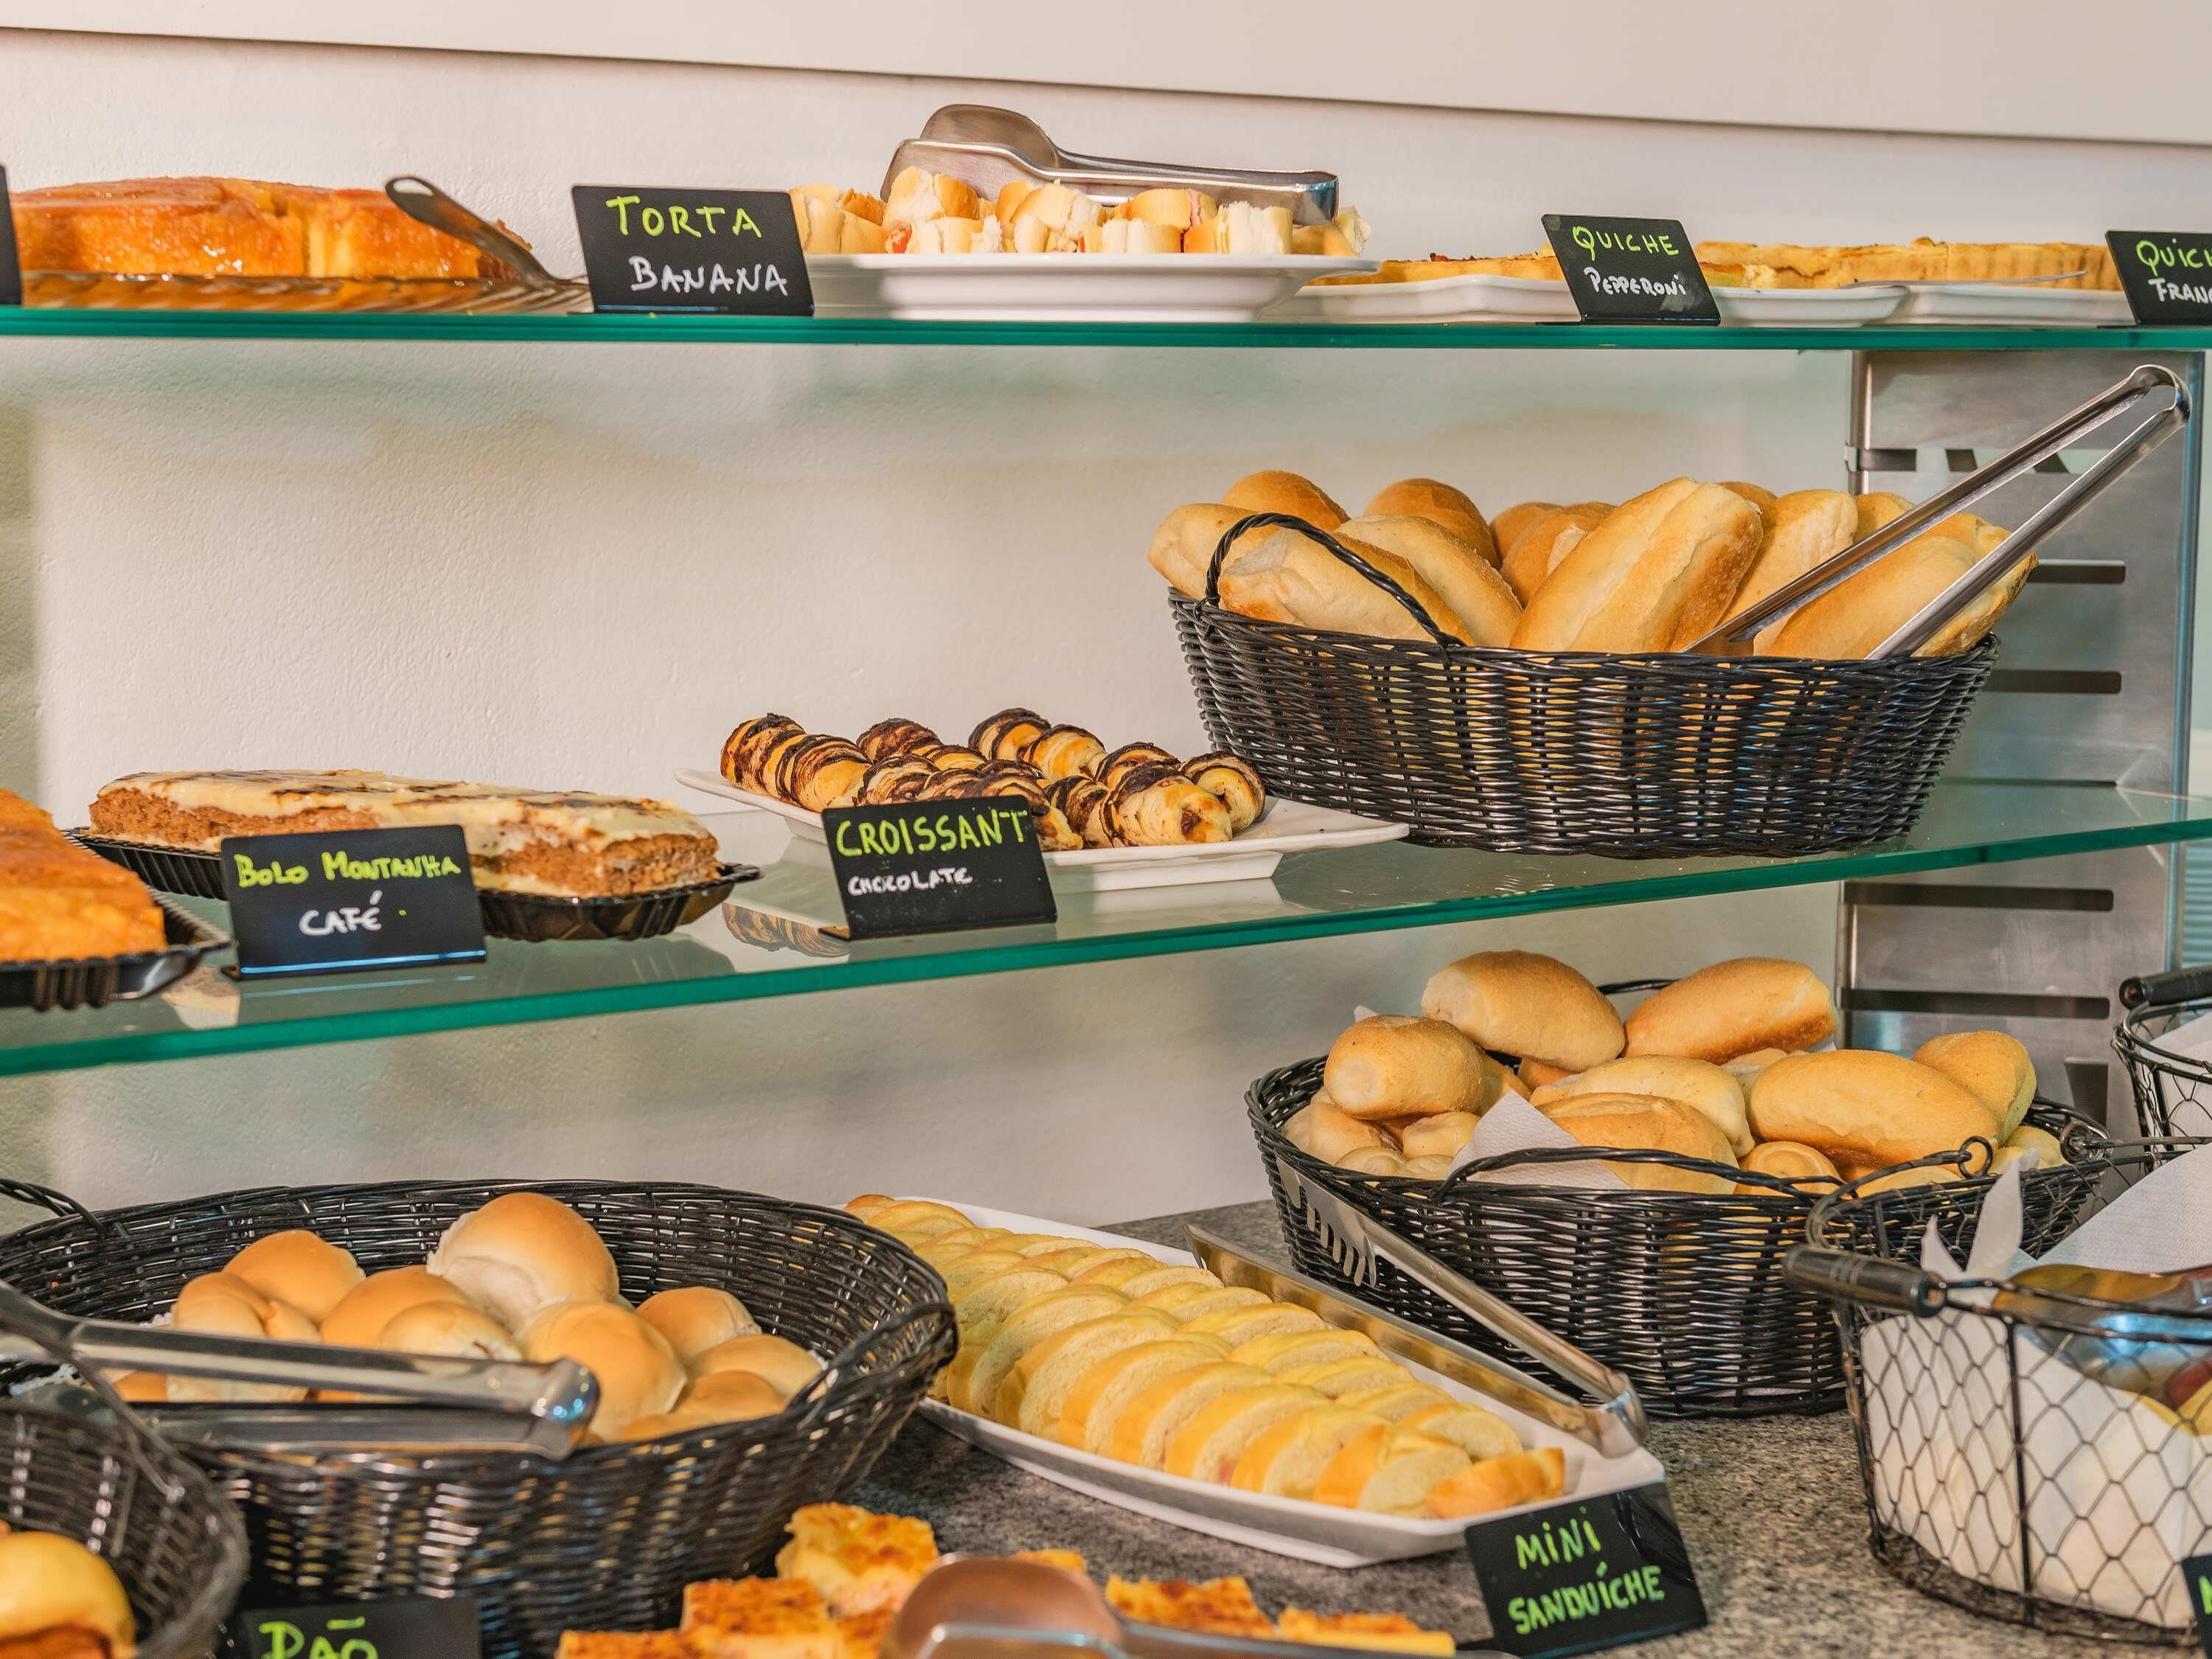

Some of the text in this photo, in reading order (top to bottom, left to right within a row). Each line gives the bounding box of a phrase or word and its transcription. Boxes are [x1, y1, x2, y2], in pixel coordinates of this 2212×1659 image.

[605, 195, 762, 238] TORTA
[1571, 225, 1680, 261] QUICHE
[628, 255, 788, 296] BANANA
[835, 808, 1028, 857] CROISSANT
[299, 889, 383, 936] CAFÉ
[1508, 1561, 1665, 1635] SANDUÍCHE
